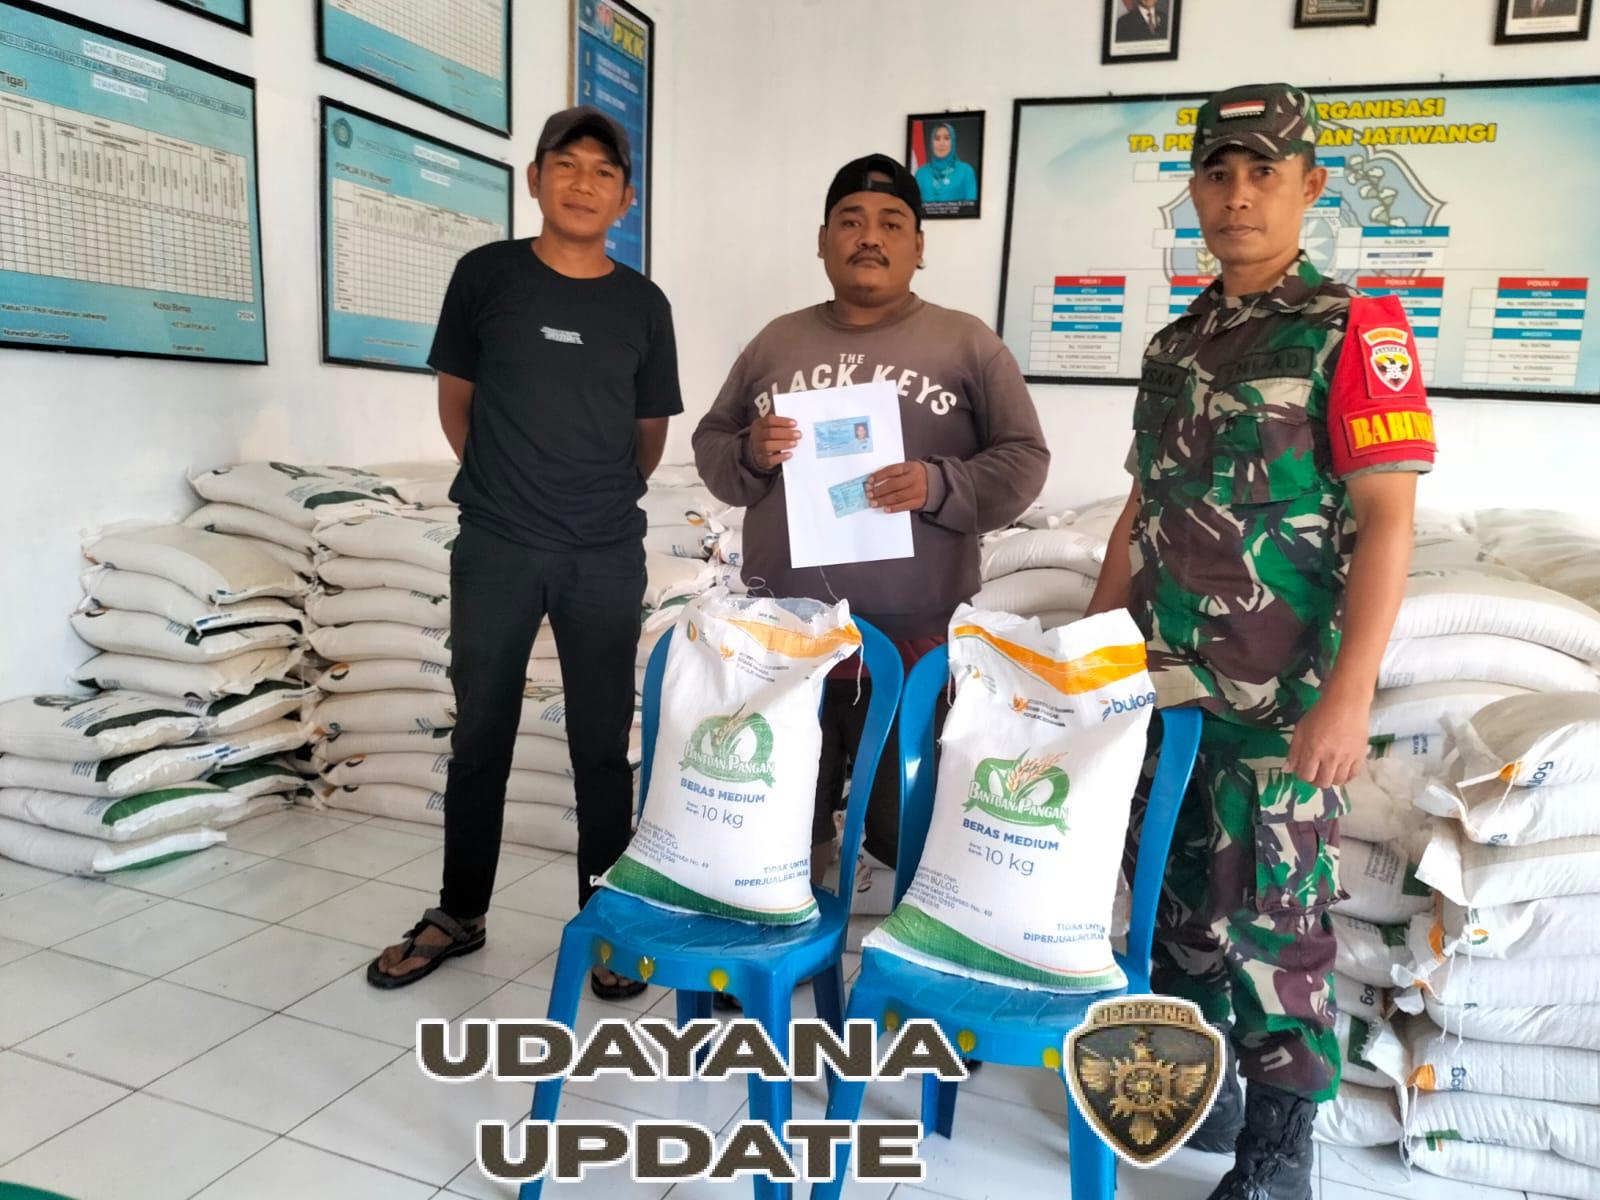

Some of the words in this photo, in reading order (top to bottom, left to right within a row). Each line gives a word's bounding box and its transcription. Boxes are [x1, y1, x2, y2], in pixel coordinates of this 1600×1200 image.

[612, 22, 646, 61] PKK
[1316, 98, 1446, 121] RGANISASI
[1129, 134, 1159, 152] TP.
[1163, 133, 1194, 152] PK
[1359, 122, 1498, 147] JATIWANGI
[839, 353, 865, 364] THE
[871, 364, 958, 416] KEYS
[1350, 410, 1438, 450] BABIN
[684, 740, 727, 771] BANTUAN
[728, 753, 775, 774] PANGAN
[680, 777, 715, 798] BERAS
[718, 790, 765, 803] MEDIUM
[968, 780, 1017, 812] BANTUAN
[1017, 798, 1069, 820] PANGAN
[702, 804, 718, 822] 10
[722, 809, 744, 829] kg
[652, 828, 679, 851] BULOG
[962, 818, 1001, 840] BERAS
[1003, 832, 1060, 851] MEDIUM
[985, 846, 1004, 865] 10
[1009, 852, 1035, 876] kg
[930, 876, 960, 894] BULOG
